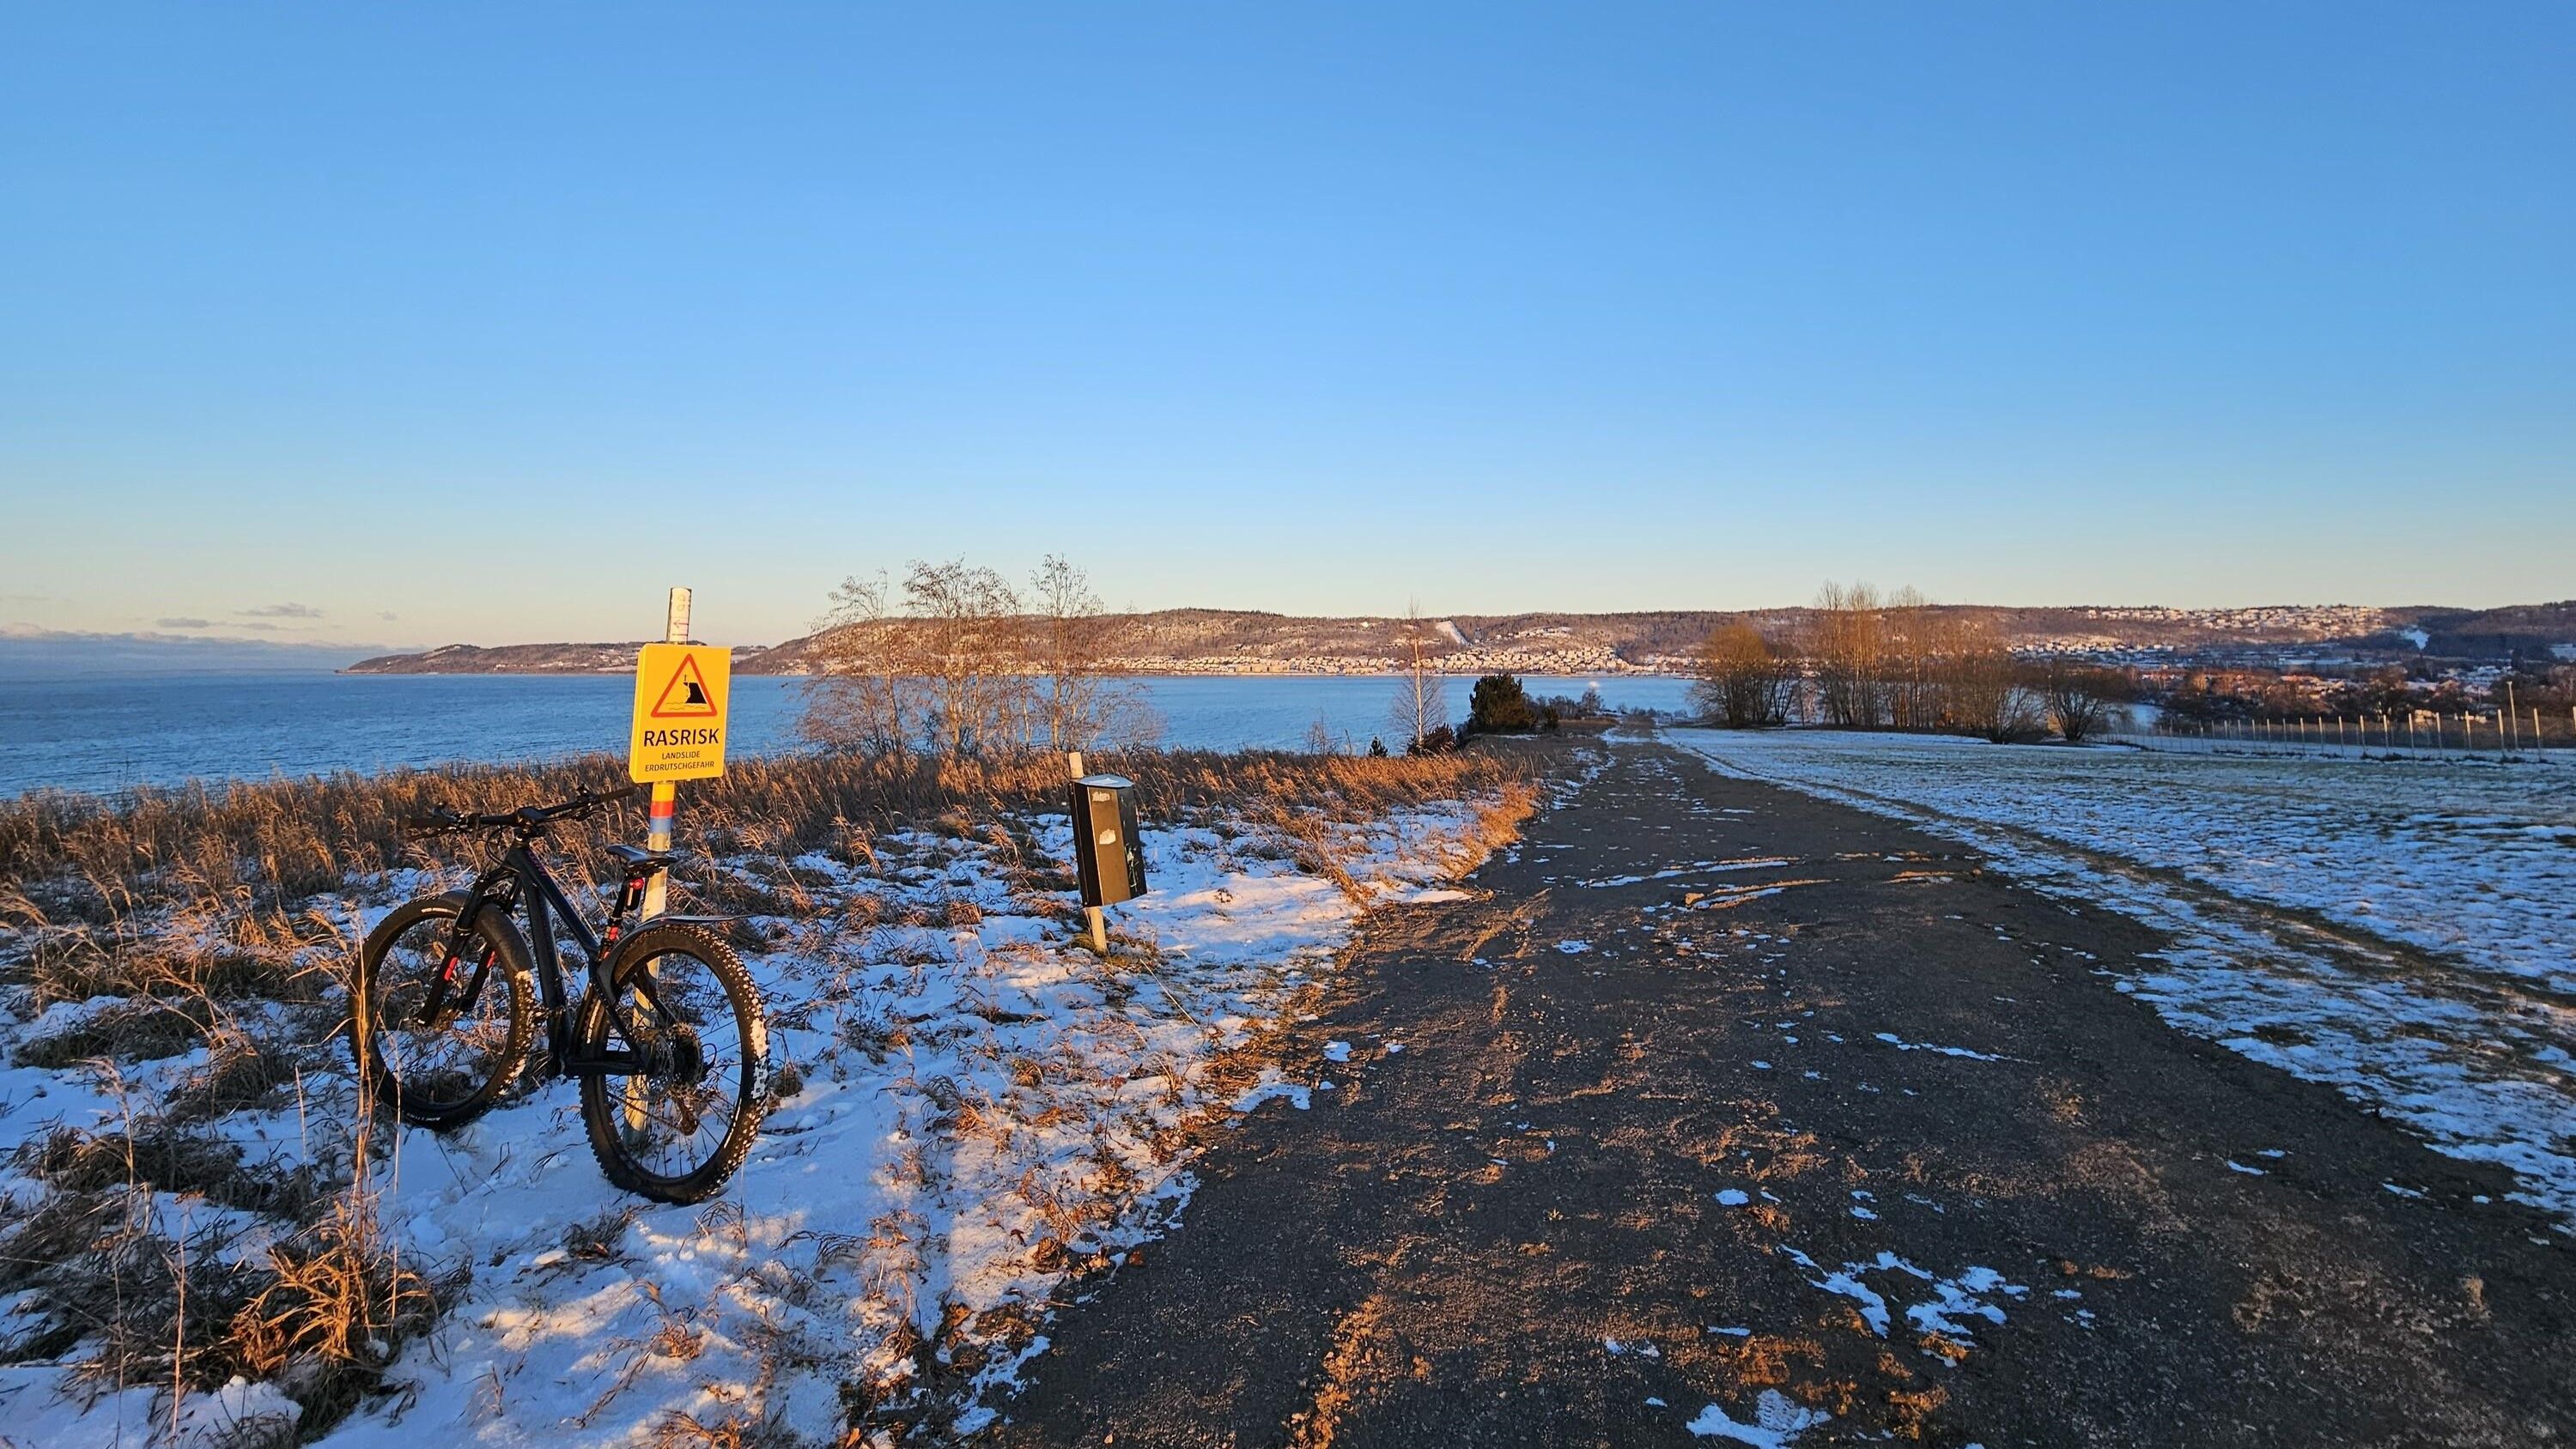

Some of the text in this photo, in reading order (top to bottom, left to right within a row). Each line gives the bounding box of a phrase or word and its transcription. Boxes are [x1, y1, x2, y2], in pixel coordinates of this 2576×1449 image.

[643, 728, 720, 747] RASRISK
[661, 750, 701, 760] LANDSLIDE
[645, 761, 714, 772] ERDRUTSCHGEFAHR
